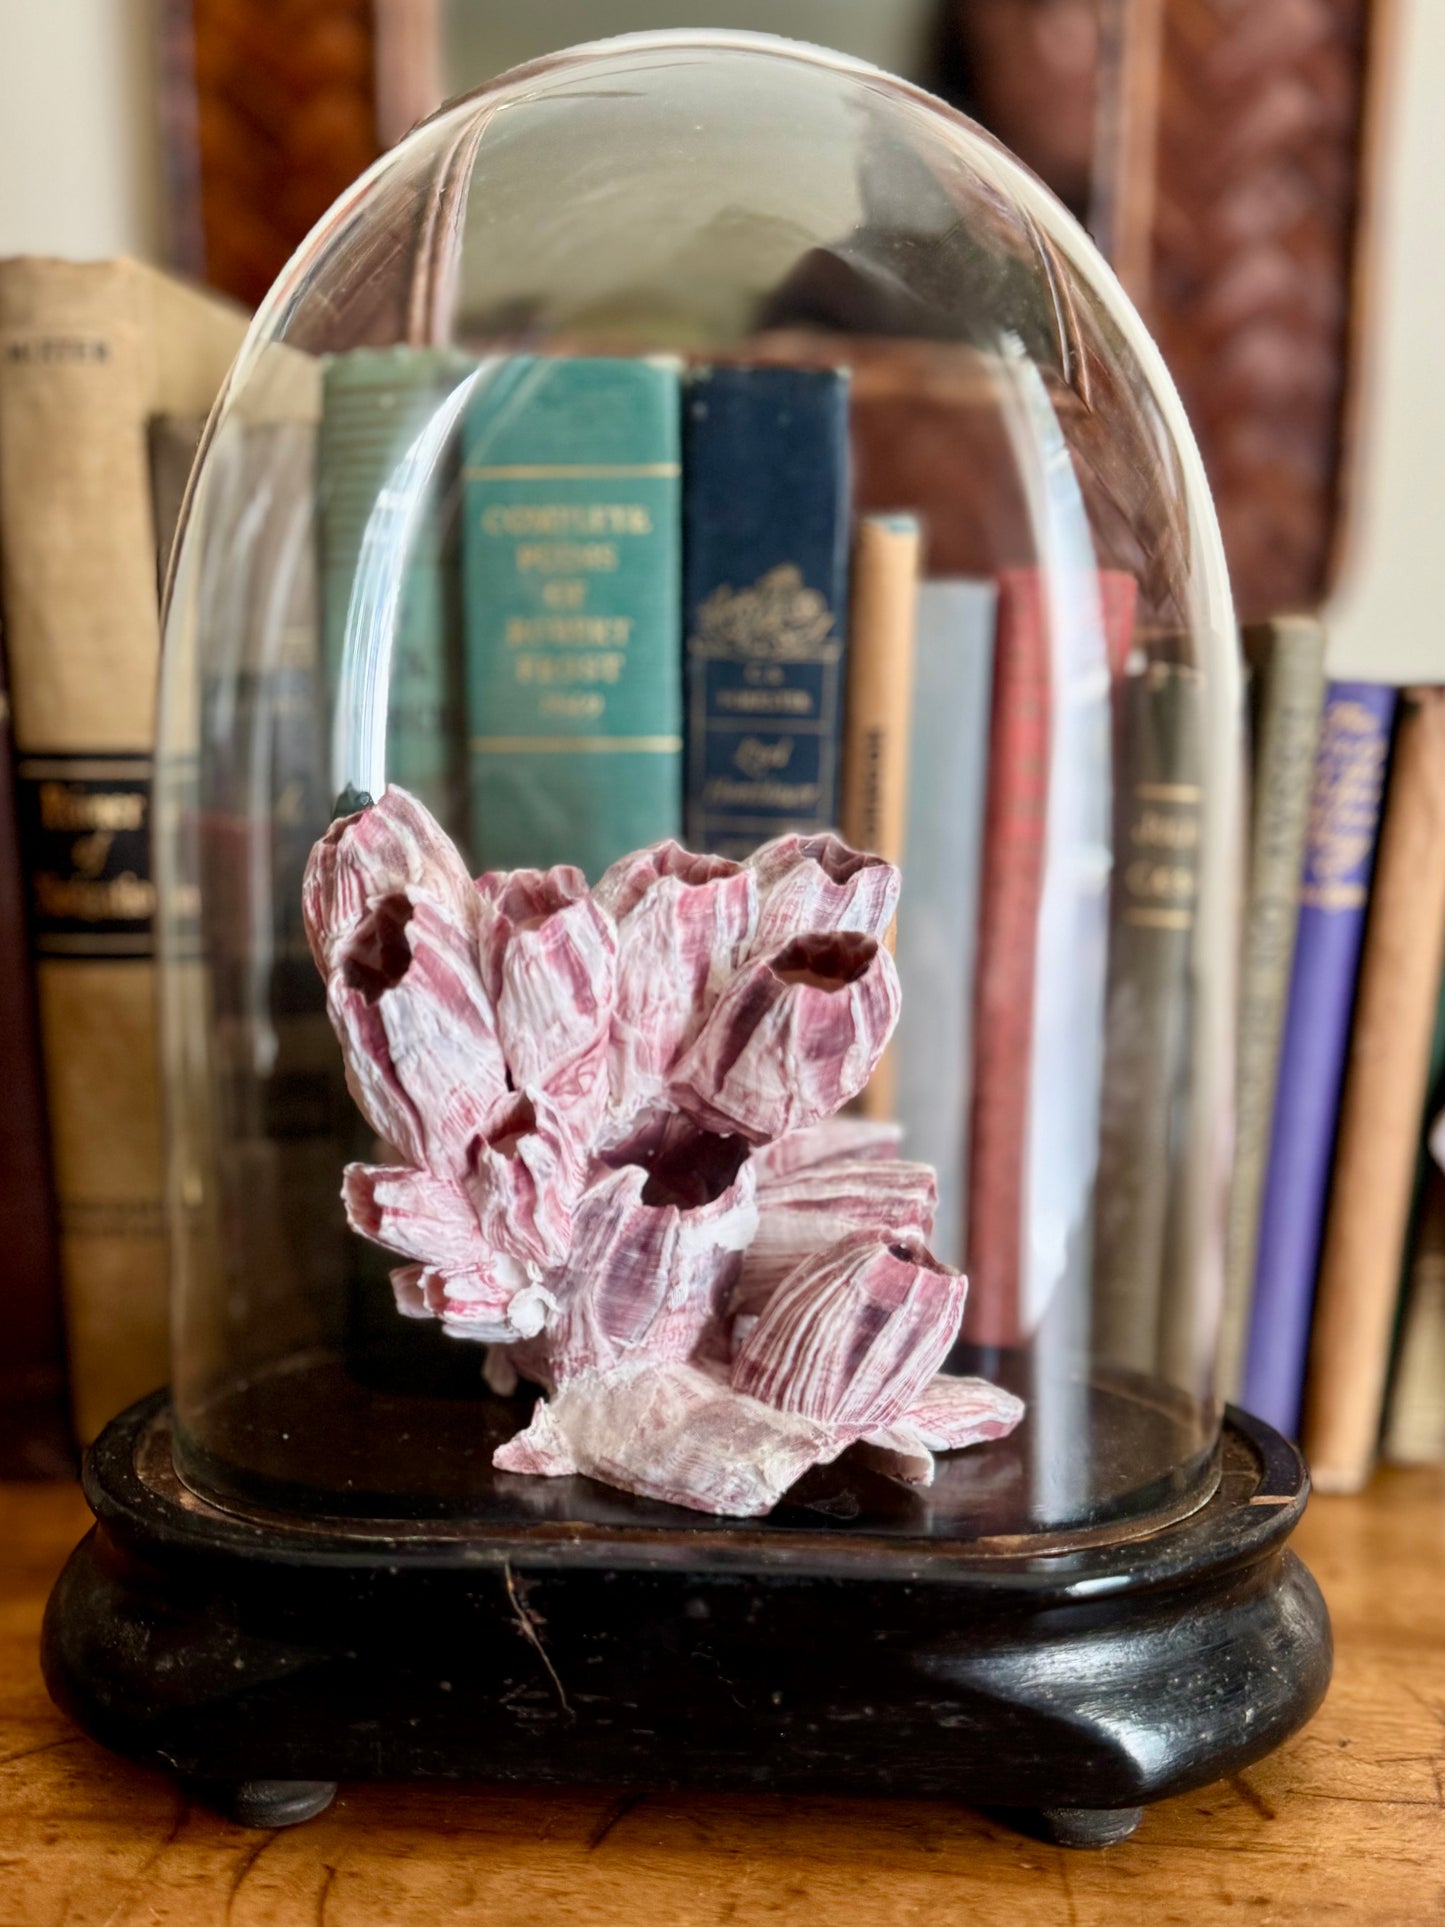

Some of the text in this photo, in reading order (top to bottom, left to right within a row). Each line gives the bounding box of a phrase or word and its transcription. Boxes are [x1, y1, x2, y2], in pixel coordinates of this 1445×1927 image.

[482, 504, 653, 536] COMPLETE
[516, 541, 617, 572] POEMS
[505, 616, 634, 648] ROBERT
[516, 652, 624, 683] FROST
